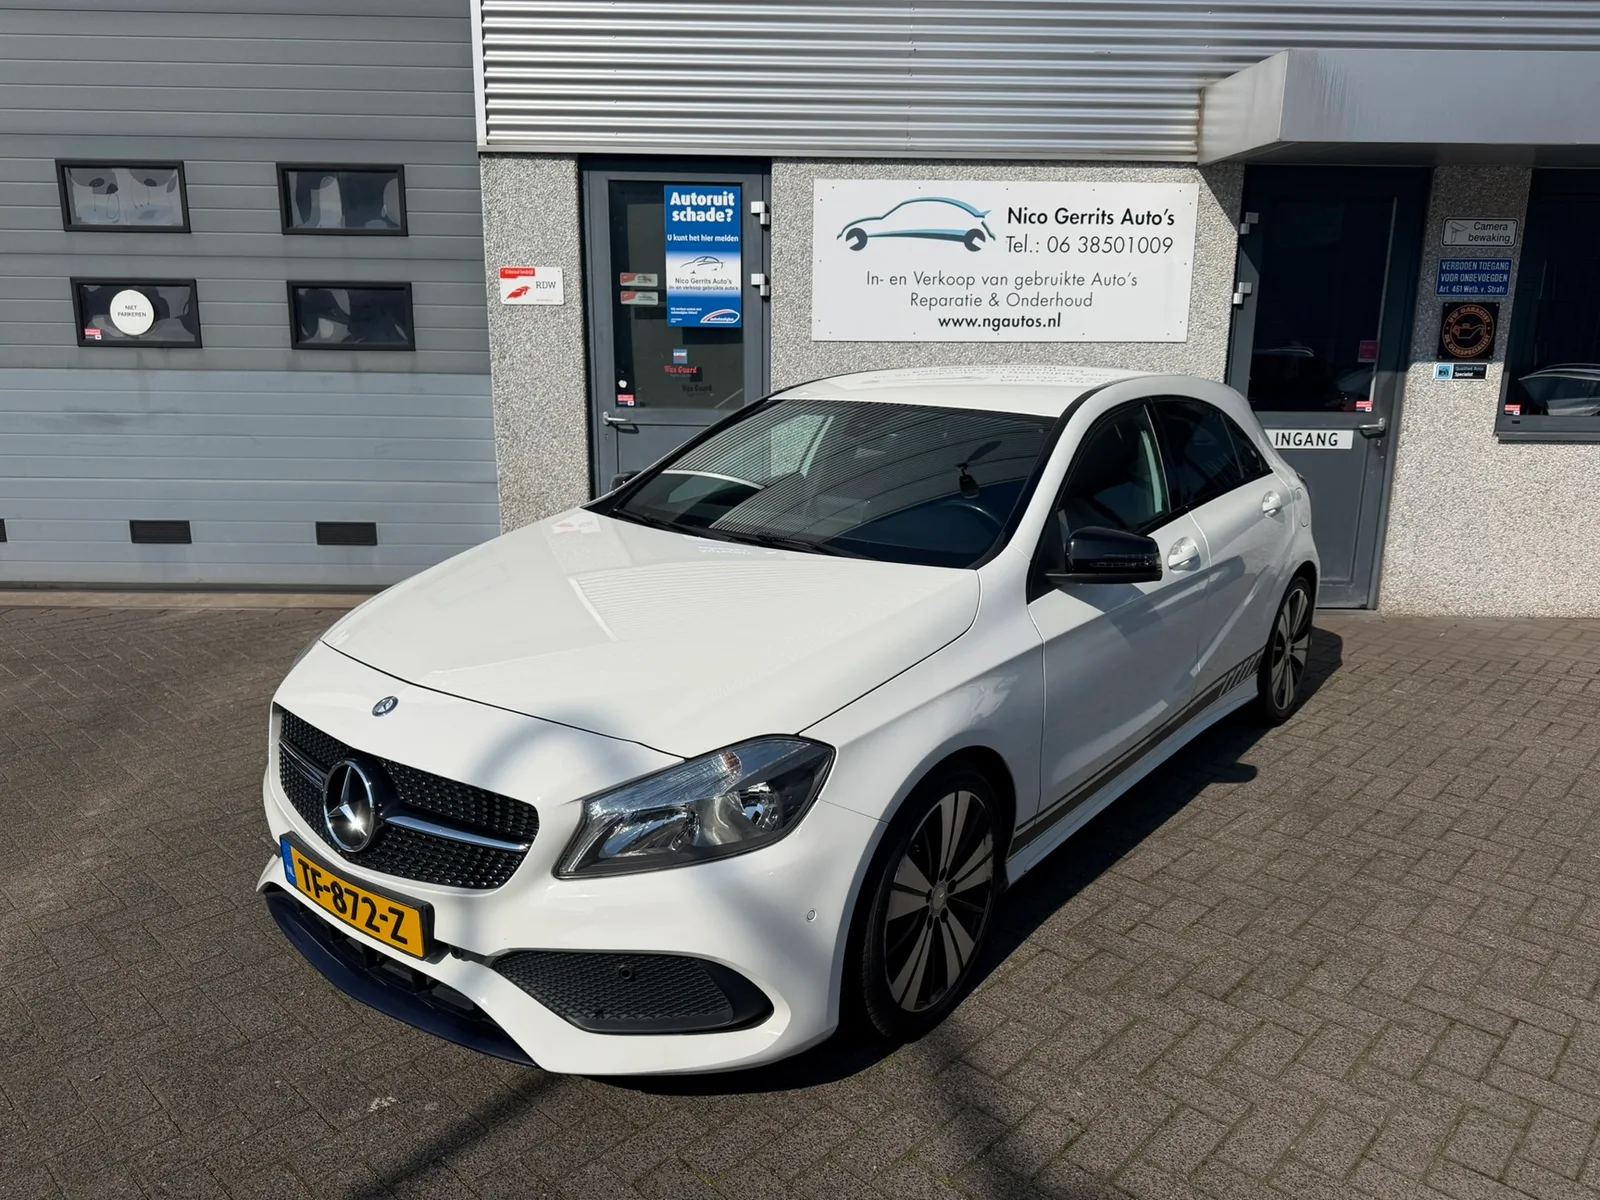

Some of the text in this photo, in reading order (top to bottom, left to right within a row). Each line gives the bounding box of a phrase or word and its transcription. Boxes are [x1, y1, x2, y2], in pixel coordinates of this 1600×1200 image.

[670, 191, 734, 206] Autoruit
[672, 207, 733, 222] schade?
[1007, 207, 1175, 226] Nico Gerrits Auto's
[1473, 222, 1508, 231] Camera
[701, 234, 714, 242] hier
[715, 234, 739, 242] melden
[1006, 235, 1173, 254] Tel.: 06 38501009
[1468, 233, 1510, 244] bewaking
[1441, 261, 1509, 271] VERBODEN TOEGANG
[690, 277, 711, 285] Gerrits
[866, 272, 1138, 290] In- en Verkoop van gebruikte Auto's
[1440, 273, 1508, 283] VOOR ONBEVOEGDEN
[535, 281, 556, 289] RDW
[1439, 285, 1450, 293] Art.
[1452, 285, 1463, 293] 461
[910, 293, 1093, 311] Reparatie & Onderhoud
[938, 313, 1061, 331] www.ngautos.nl
[664, 365, 697, 374] Wax Guard
[1275, 431, 1339, 447] INGANG
[297, 857, 408, 945] TF-872-Z
